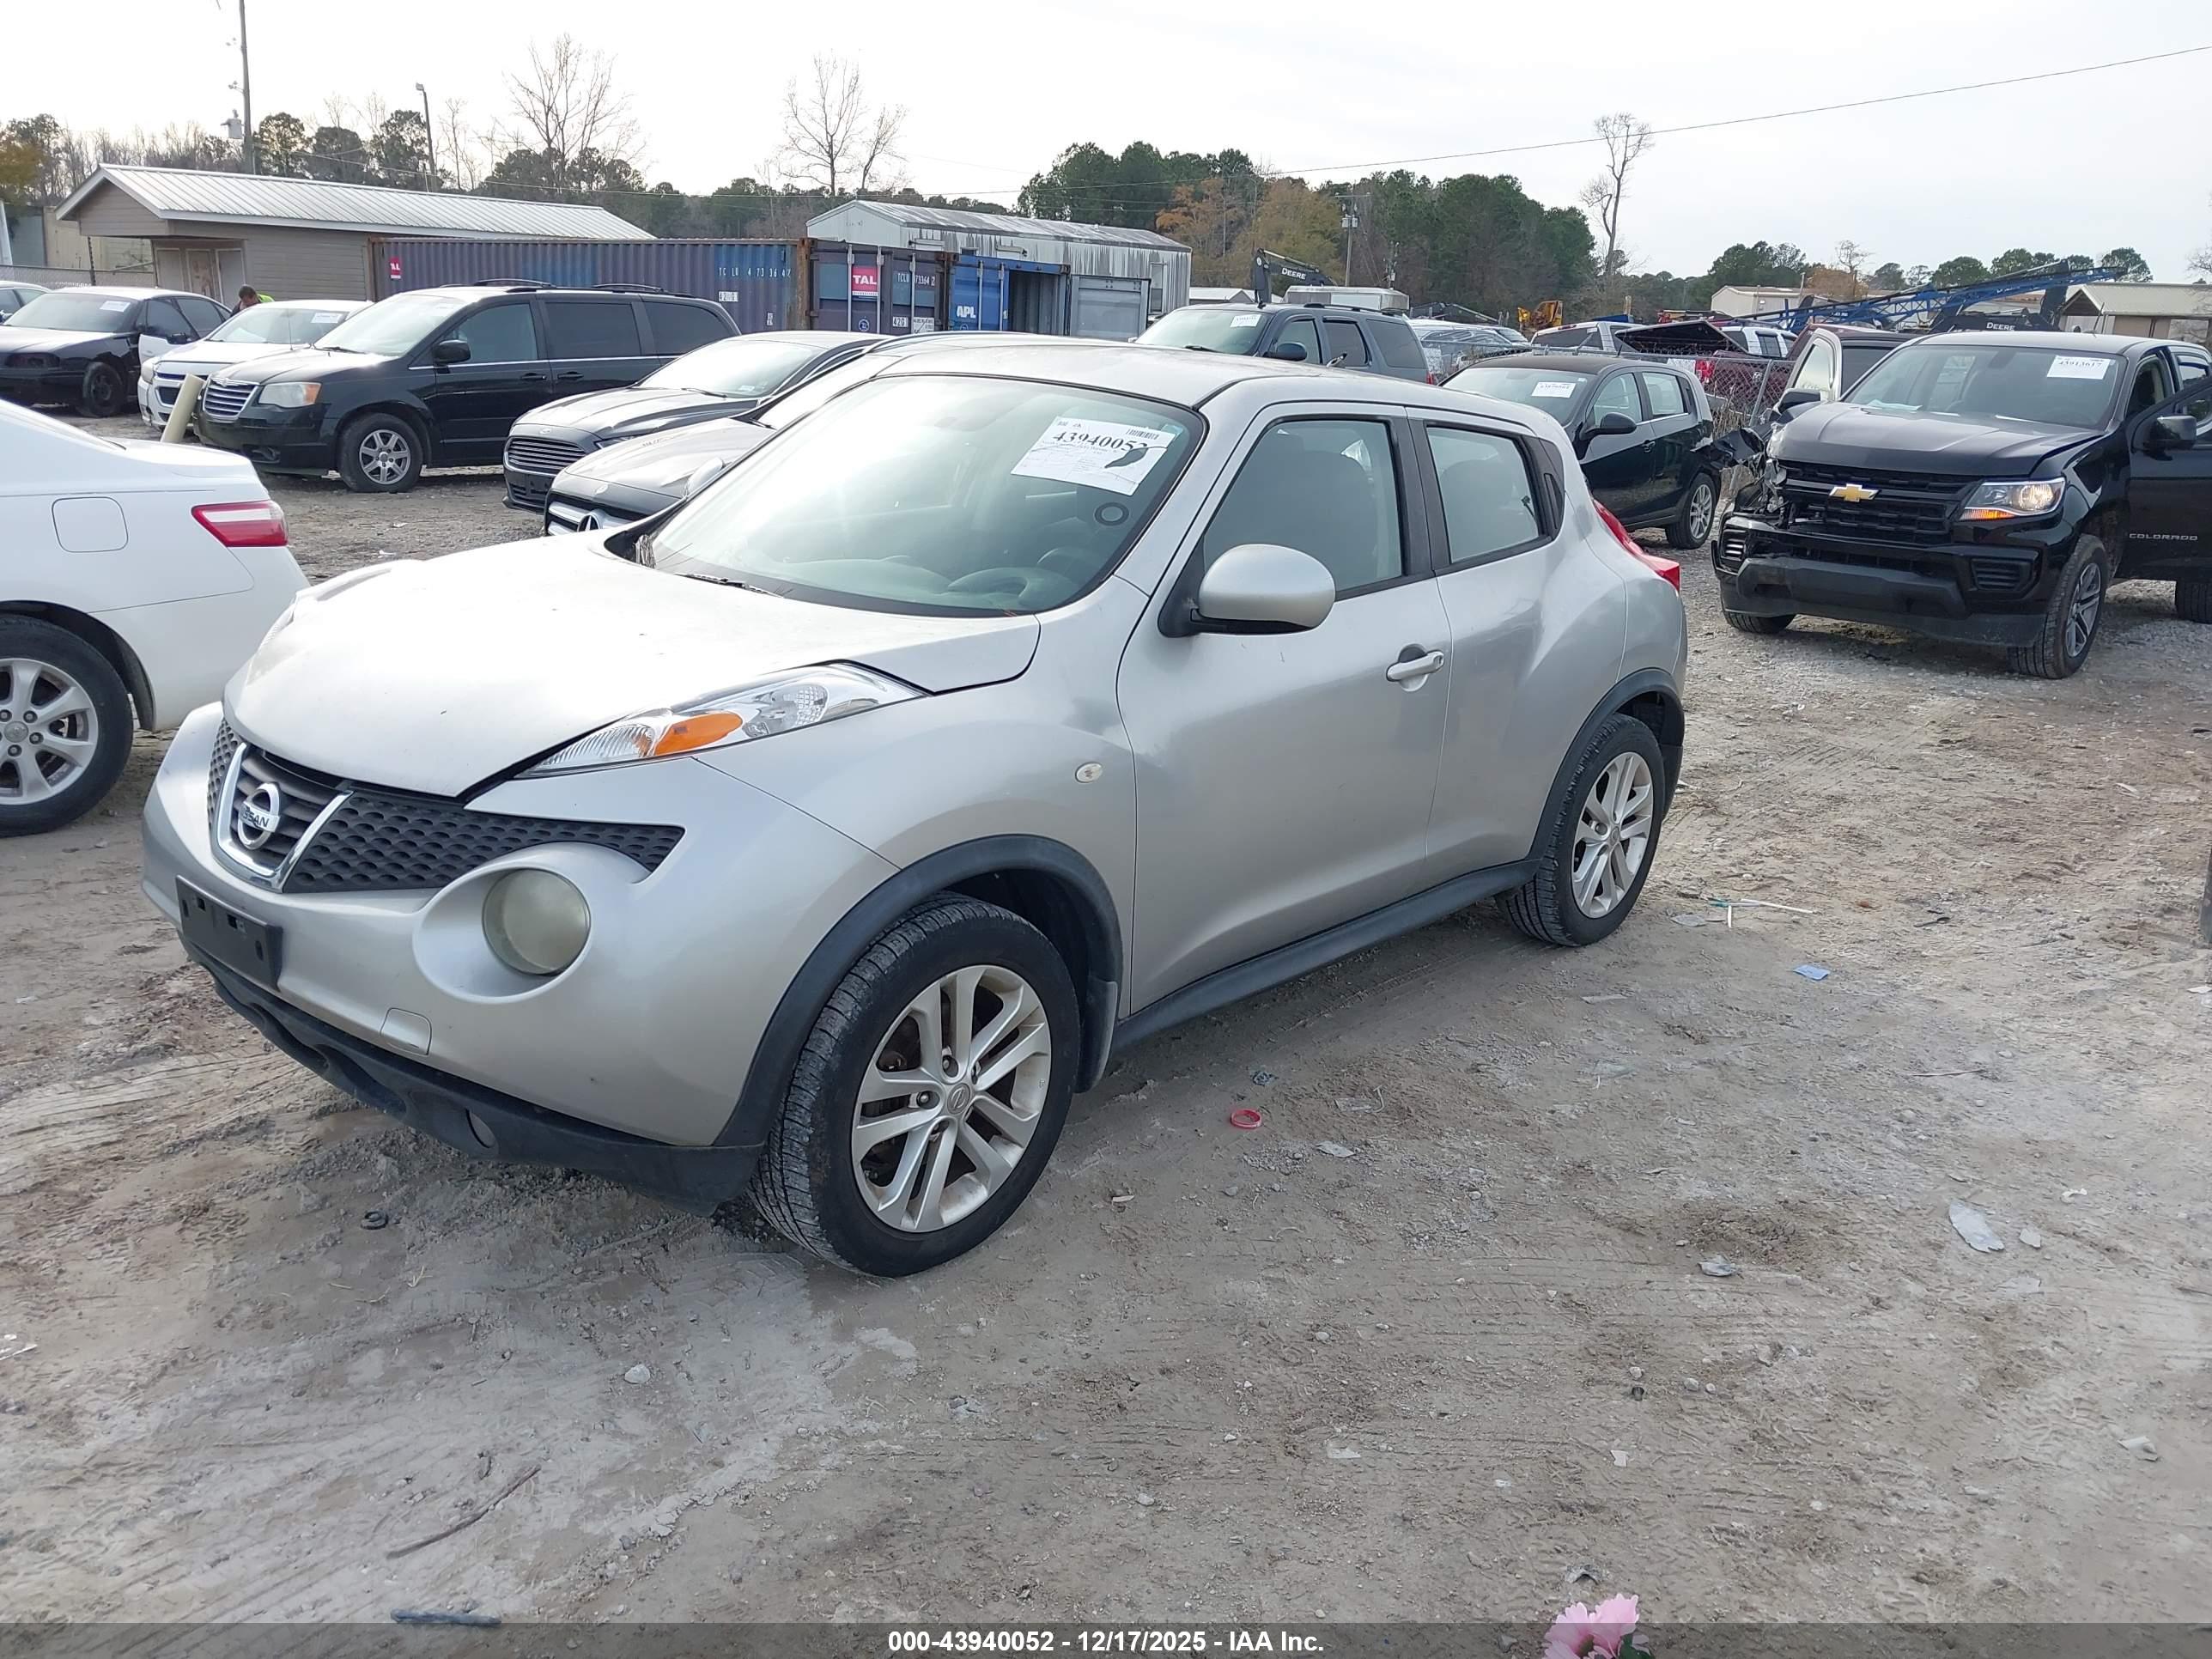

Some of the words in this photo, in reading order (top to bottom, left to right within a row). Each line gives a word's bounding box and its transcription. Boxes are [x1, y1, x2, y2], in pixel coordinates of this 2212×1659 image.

[1281, 267, 1306, 280] DEERE
[853, 275, 878, 285] TAL
[956, 305, 976, 319] APL
[1986, 322, 2015, 331] DEERE
